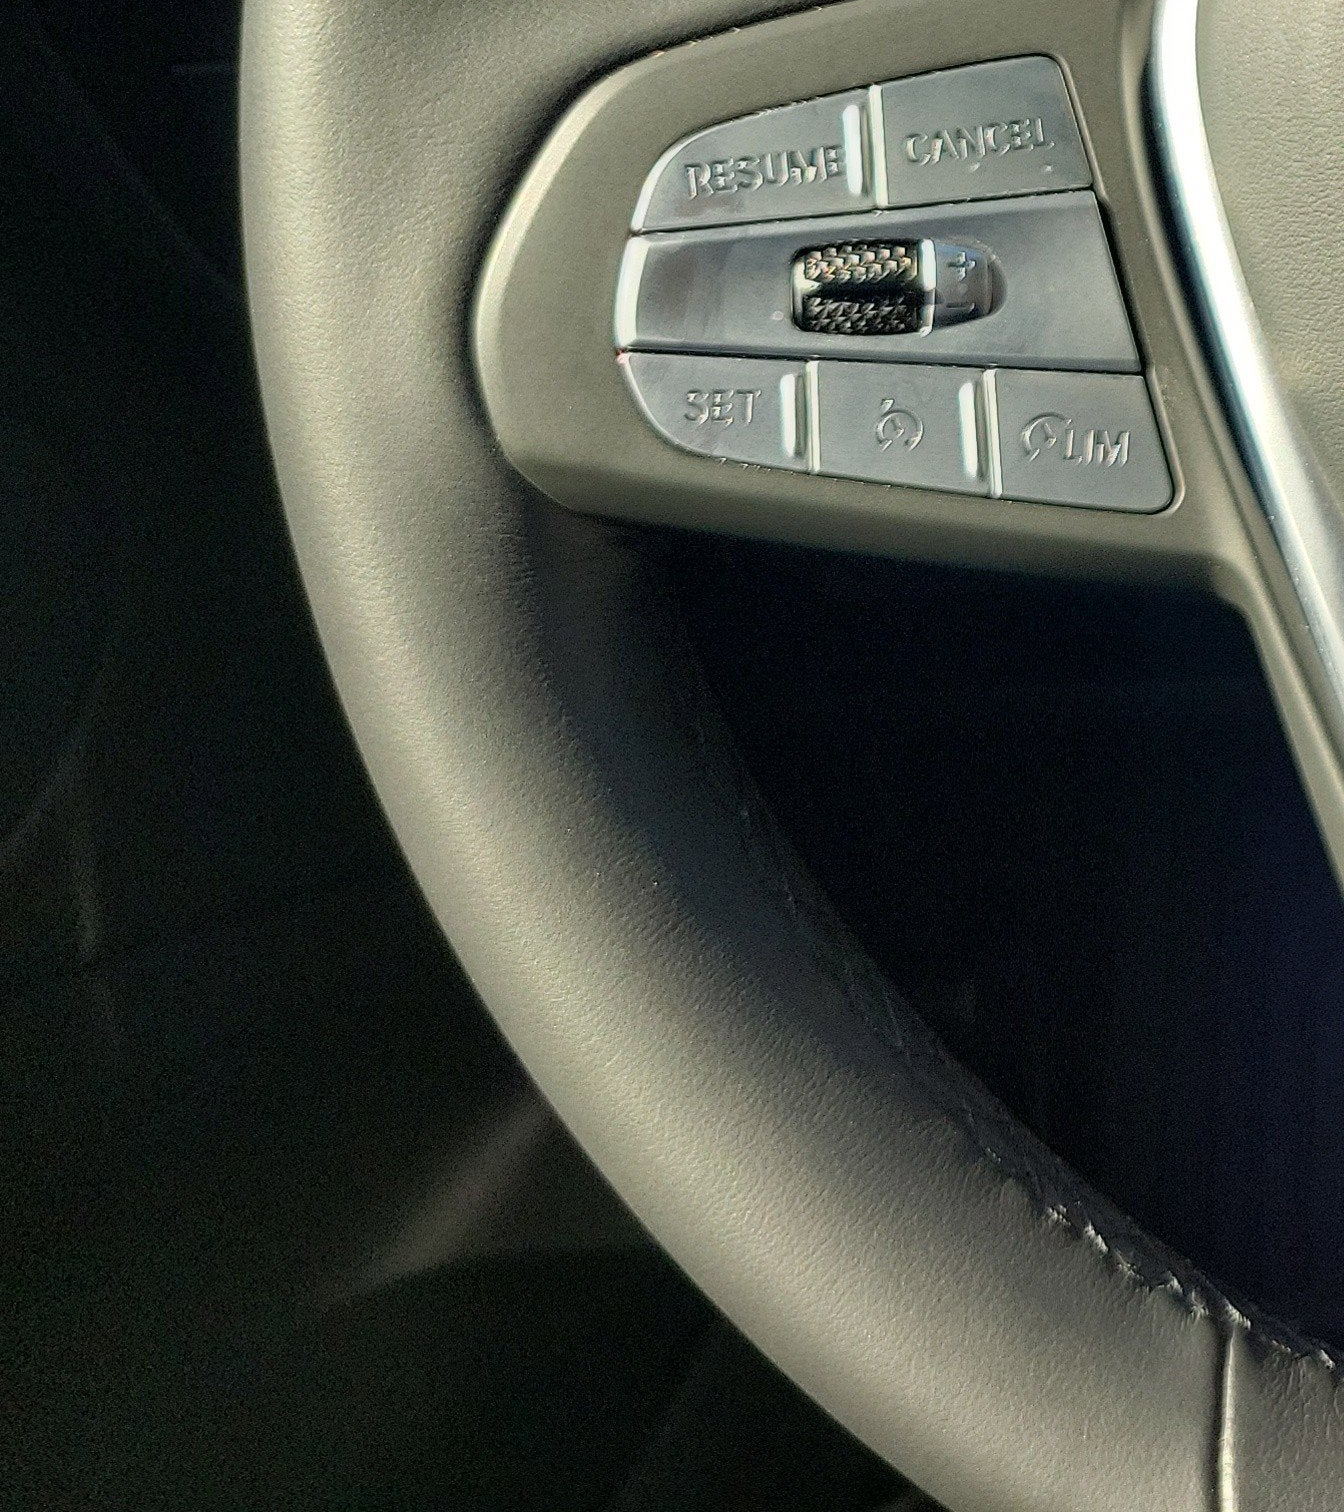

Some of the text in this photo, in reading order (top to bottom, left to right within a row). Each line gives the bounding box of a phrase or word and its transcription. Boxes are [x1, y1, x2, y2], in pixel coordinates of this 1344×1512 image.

[905, 116, 1056, 167] CANCEL
[686, 143, 845, 198] RESUME
[683, 387, 763, 427] SET
[1064, 418, 1131, 469] LIM
